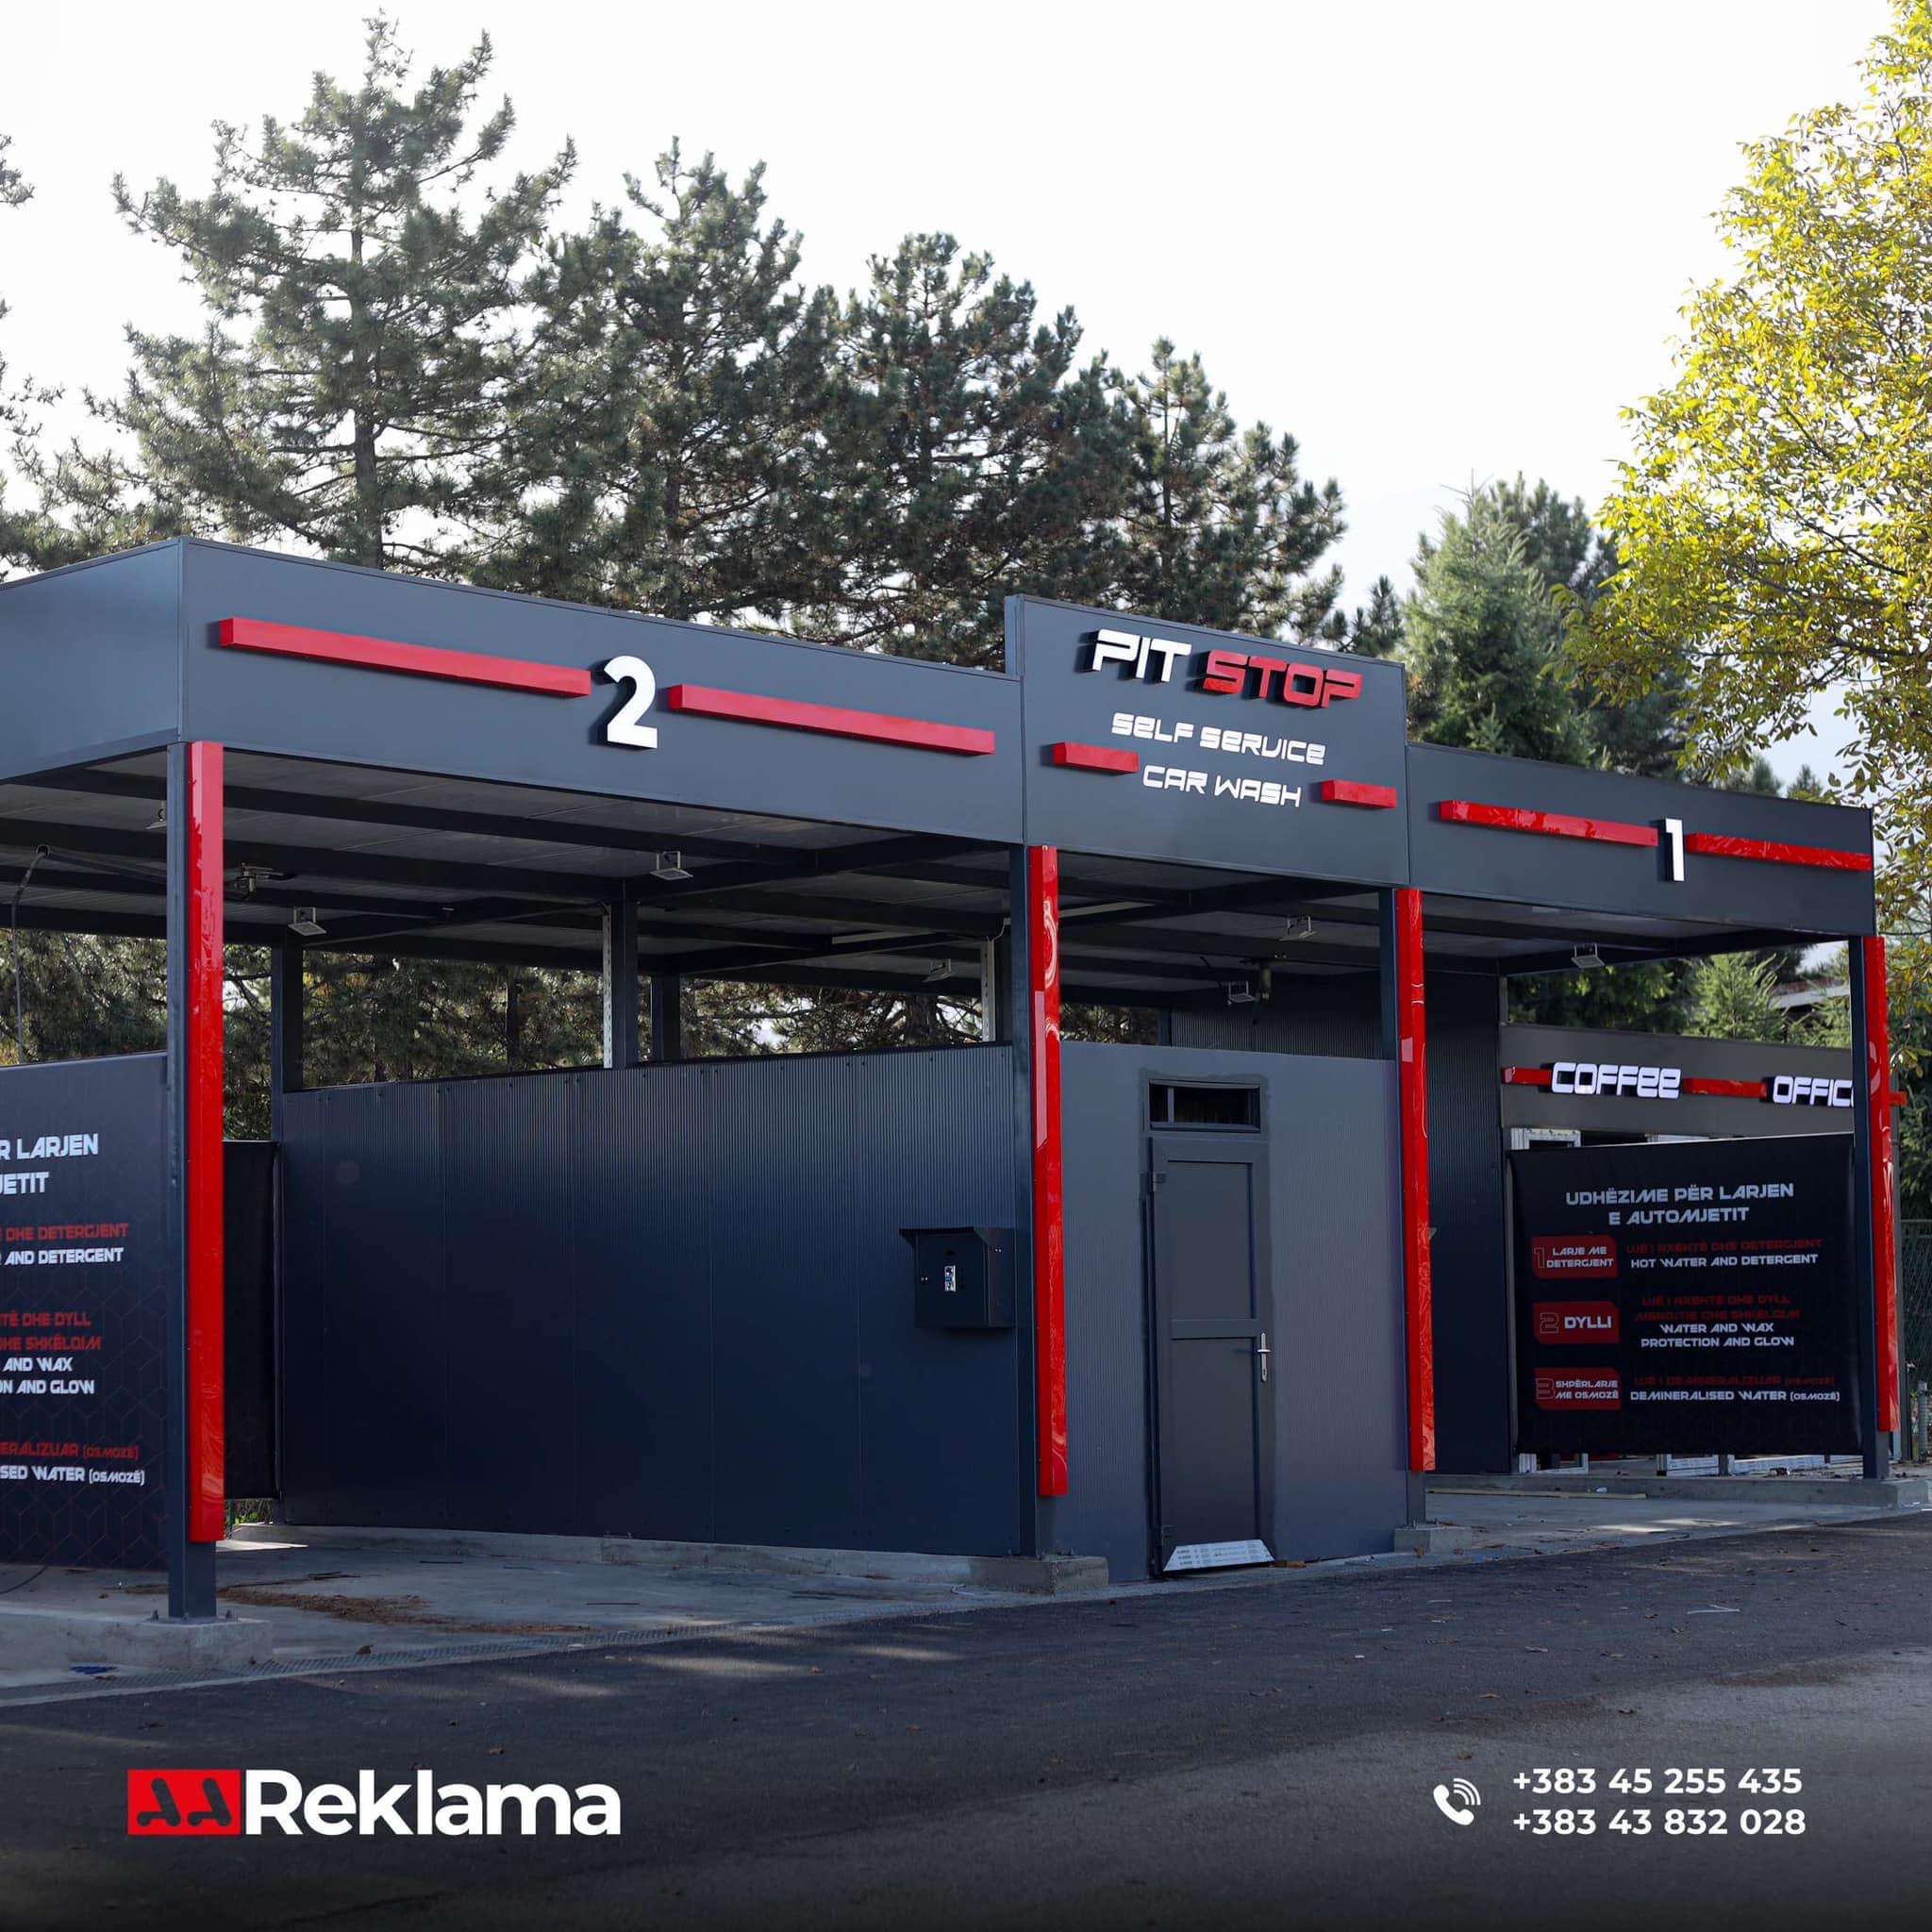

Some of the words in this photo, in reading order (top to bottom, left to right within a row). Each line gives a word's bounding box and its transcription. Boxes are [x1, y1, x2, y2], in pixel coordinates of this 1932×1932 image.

[1090, 628, 1192, 683] PIT
[1202, 649, 1364, 709] STOP
[603, 655, 658, 749] 2
[1141, 764, 1208, 795] CAR
[1213, 774, 1303, 808] WASH
[1665, 817, 1685, 882] 1
[1773, 1075, 1854, 1108] OFFIC
[16, 1133, 99, 1159] LARJEN
[1565, 1187, 1669, 1207] UDHËZIME
[1674, 1184, 1714, 1201] PËR
[1719, 1183, 1794, 1200] LARJEN
[1608, 1211, 1622, 1225] E
[1626, 1207, 1750, 1224] AUTOMJETIT
[5, 1251, 35, 1265] AND
[39, 1247, 125, 1264] DETERGENT
[1552, 1247, 1586, 1257] LARJE
[1588, 1246, 1607, 1256] ME
[1630, 1258, 1657, 1269] HOT
[1660, 1257, 1707, 1268] WATER
[1710, 1256, 1739, 1266] AND
[1740, 1254, 1819, 1266] DETERGENT
[1564, 1316, 1612, 1329] DYLLI
[1659, 1324, 1707, 1334] WATER
[1709, 1323, 1738, 1333] AND
[1740, 1323, 1774, 1333] WAX
[1641, 1338, 1720, 1348] PROTECTION
[1723, 1337, 1751, 1347] AND
[1754, 1337, 1794, 1346] GLOW
[3, 1357, 33, 1372] AND
[36, 1357, 74, 1372] WAX
[16, 1379, 46, 1394] AND
[49, 1379, 95, 1394] GLOW
[1630, 1391, 1735, 1402] DEMINERALISED
[1739, 1391, 1788, 1401] WATER
[32, 1466, 86, 1482] WATER
